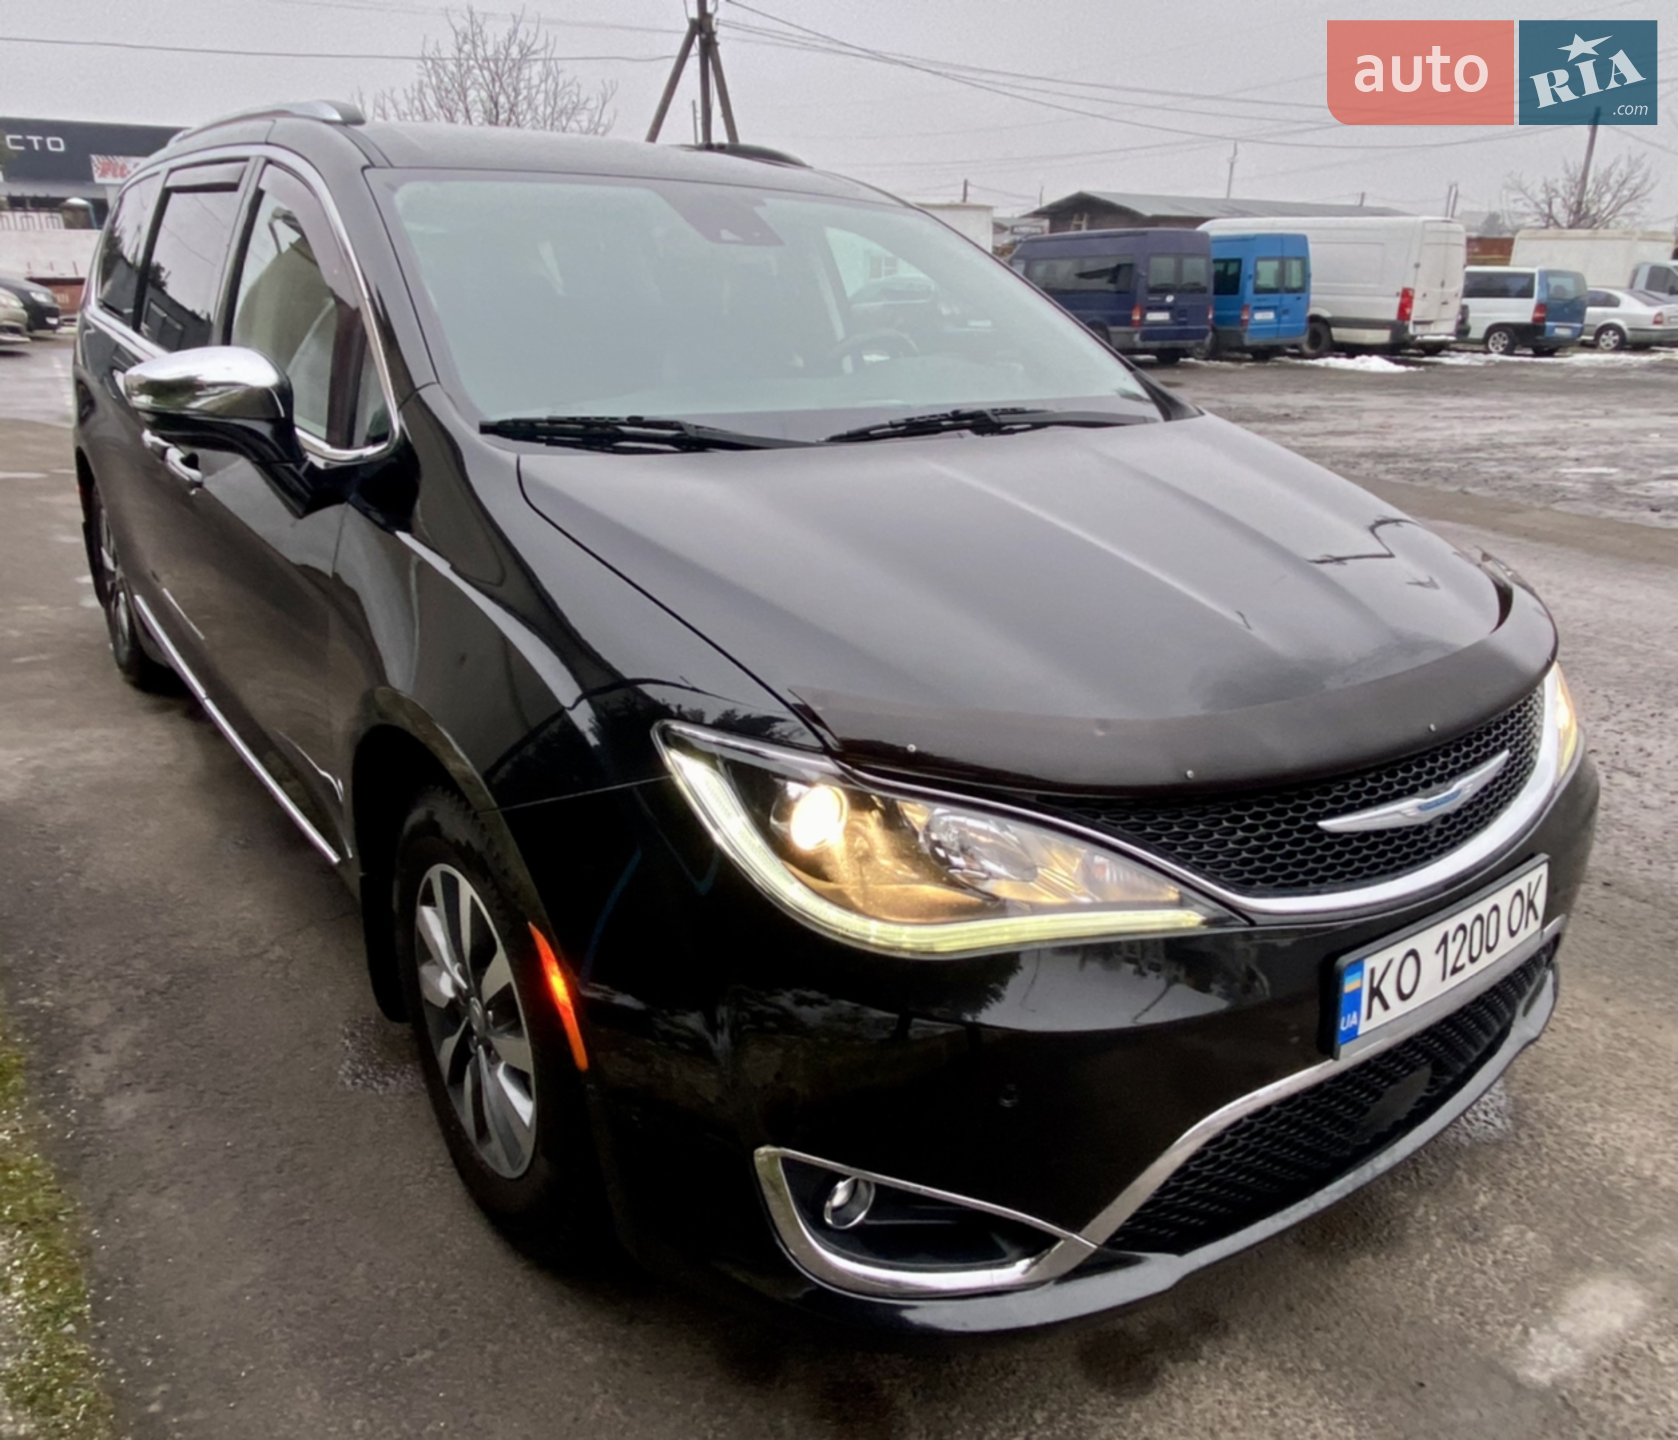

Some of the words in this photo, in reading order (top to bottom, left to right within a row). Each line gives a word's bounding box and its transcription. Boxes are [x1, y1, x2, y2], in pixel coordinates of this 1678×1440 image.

[1366, 948, 1422, 1021] KO
[1435, 904, 1501, 983] 1200
[1507, 874, 1543, 939] OK
[1340, 1011, 1359, 1031] UA
